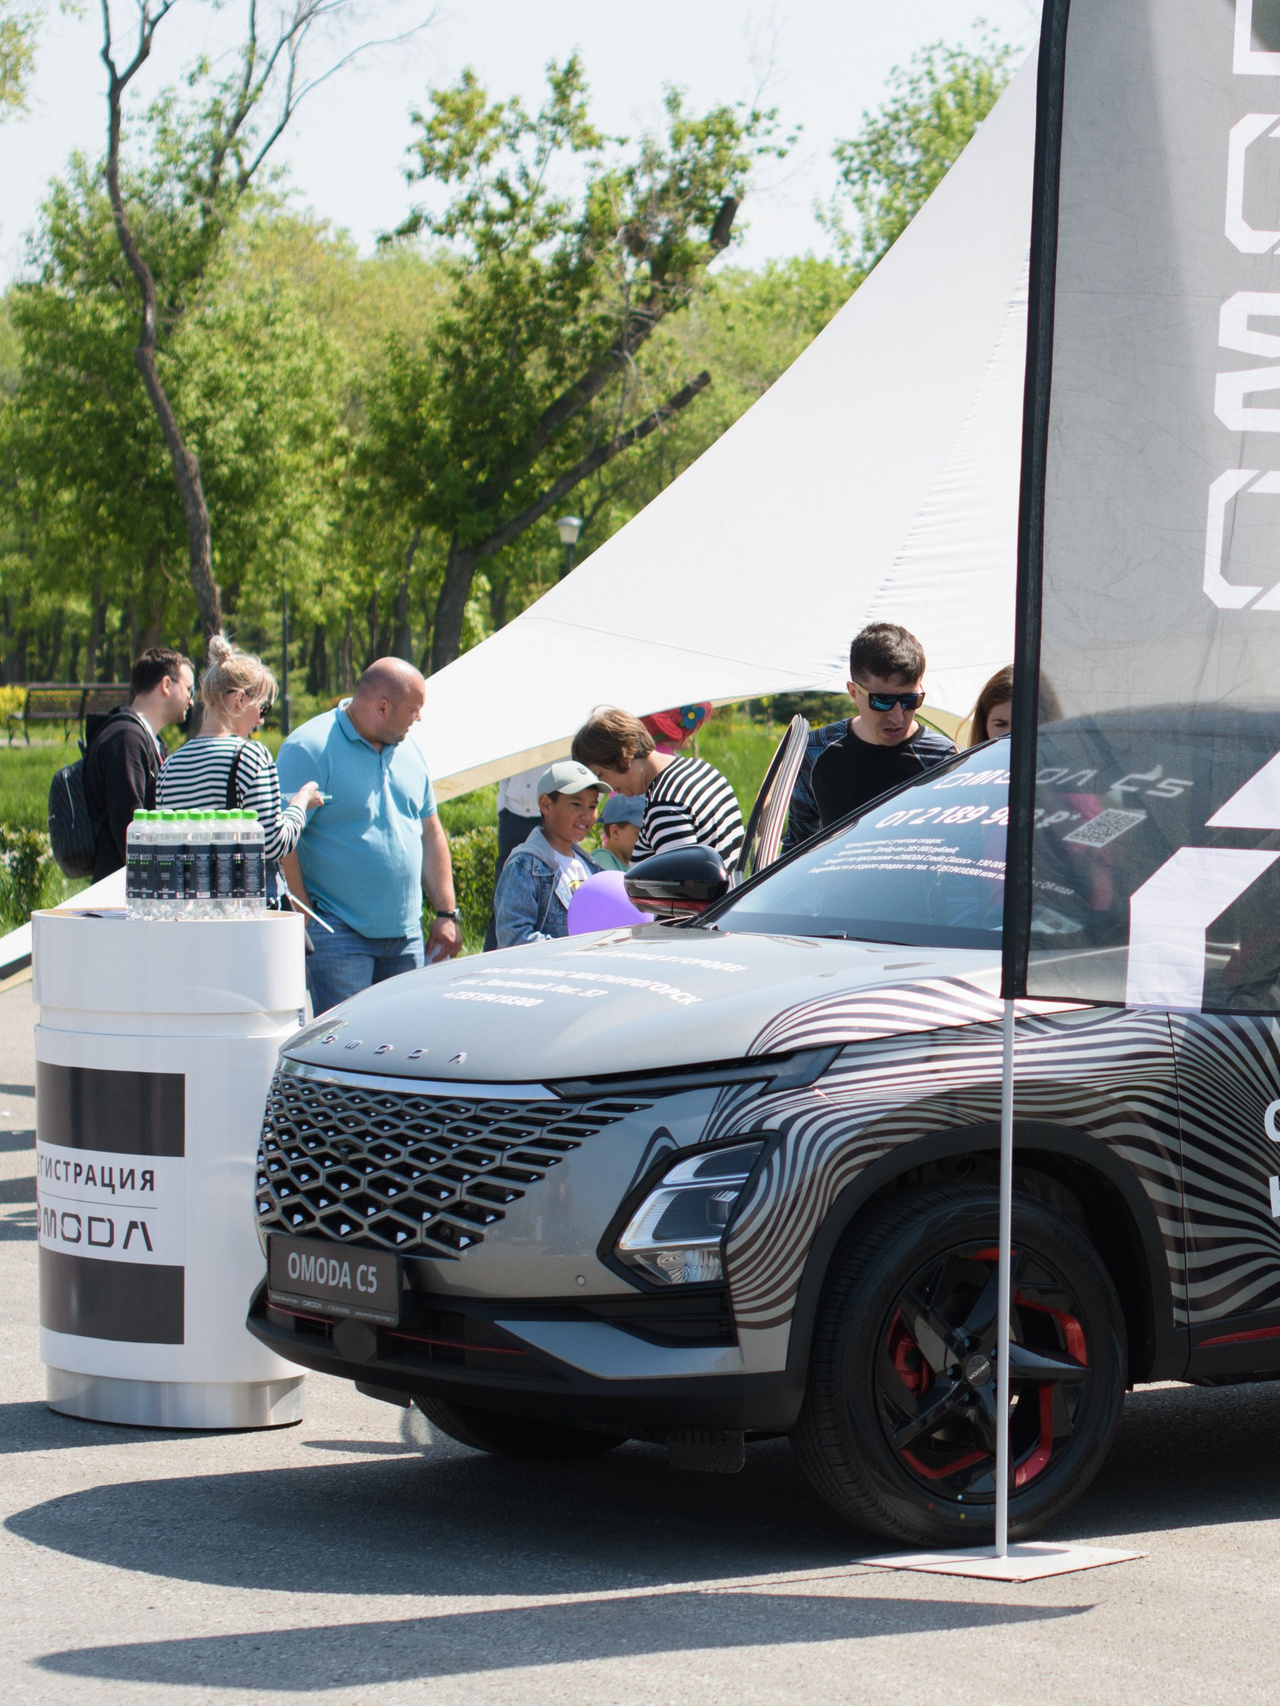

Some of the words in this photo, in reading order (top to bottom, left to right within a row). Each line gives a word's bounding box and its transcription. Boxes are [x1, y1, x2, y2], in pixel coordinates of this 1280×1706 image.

[1110, 771, 1194, 799] C5
[875, 808, 922, 828] ОТ
[908, 807, 941, 824] 2
[931, 806, 989, 824] 189
[567, 971, 703, 1006] МАГНИТОГОРСК
[577, 989, 609, 998] 57
[37, 1153, 155, 1195] ГИСТРАЦИЯ
[36, 1203, 153, 1252] MODA
[287, 1252, 352, 1289] OMODA
[356, 1264, 378, 1293] C5
